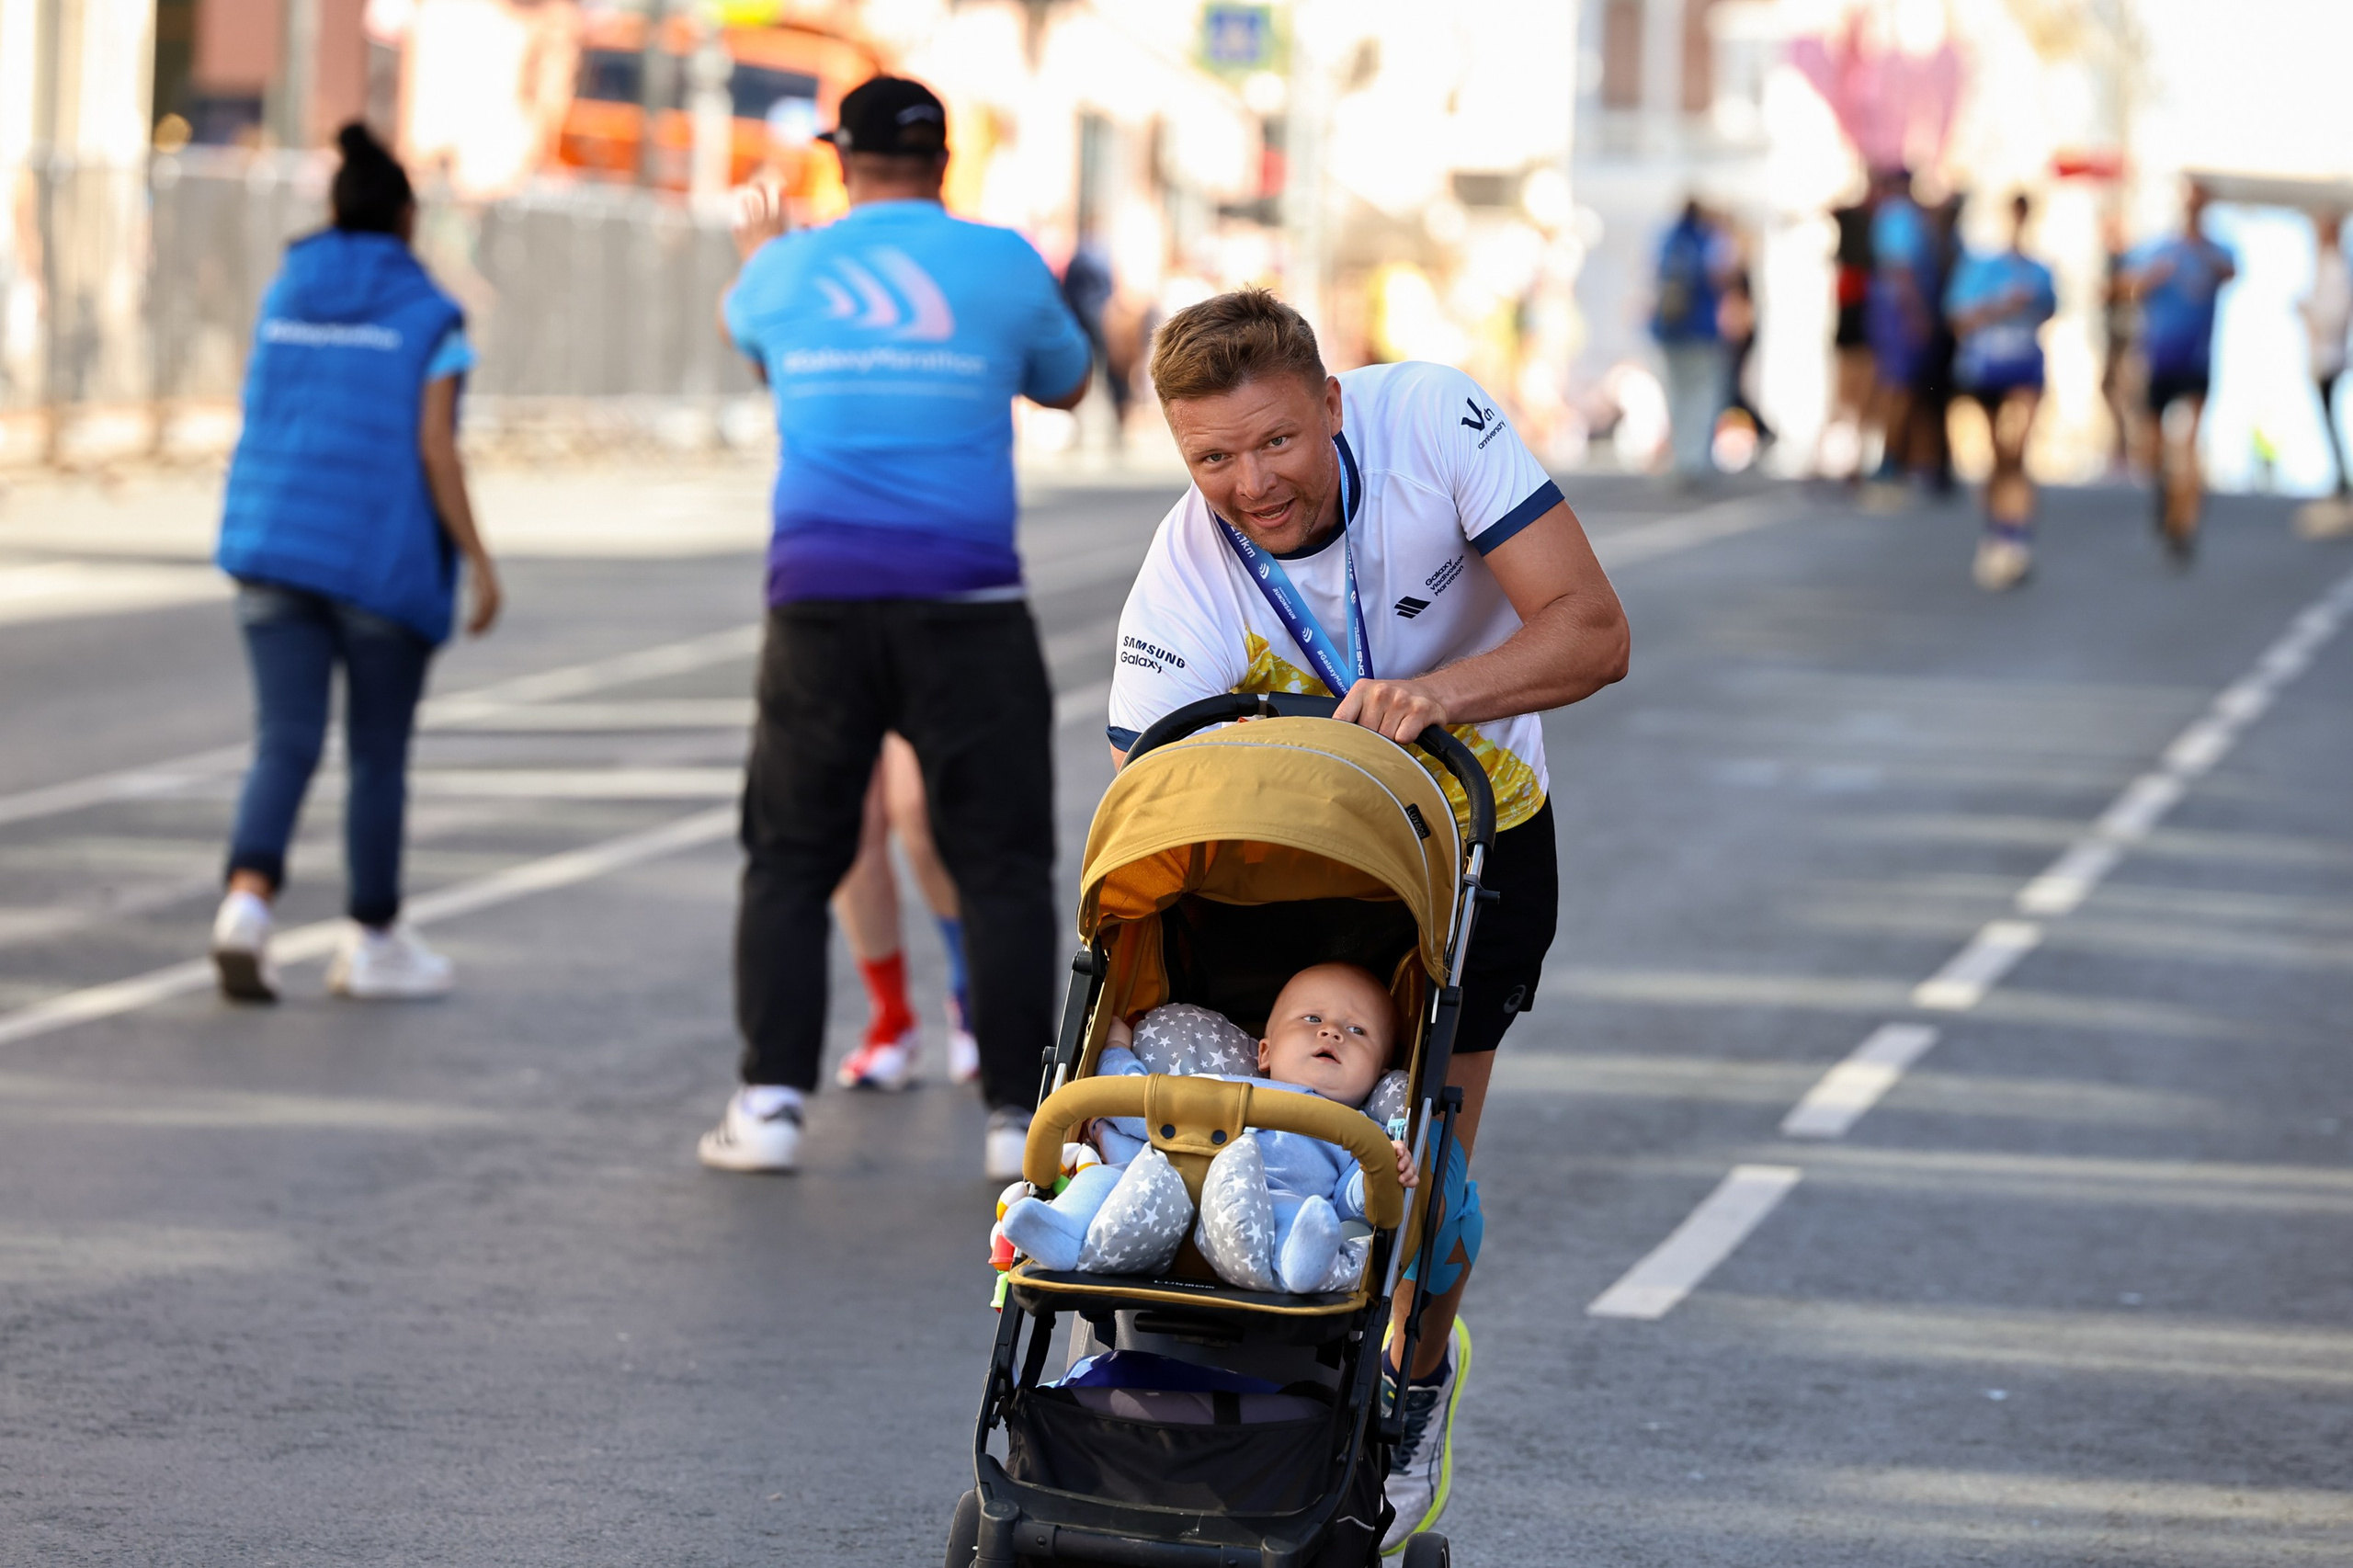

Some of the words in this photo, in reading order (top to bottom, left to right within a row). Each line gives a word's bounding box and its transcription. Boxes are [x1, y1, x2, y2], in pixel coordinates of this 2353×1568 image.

[1478, 420, 1506, 450] anniversary
[1425, 558, 1452, 586] Galaxy
[1429, 553, 1465, 591] Vladivostok
[1434, 564, 1464, 597] Marathon
[1120, 651, 1163, 674] Galaxy
[1123, 635, 1186, 665] SAMSUNG
[1356, 651, 1365, 676] DNS
[1316, 649, 1348, 695] #GalaxyMarat
